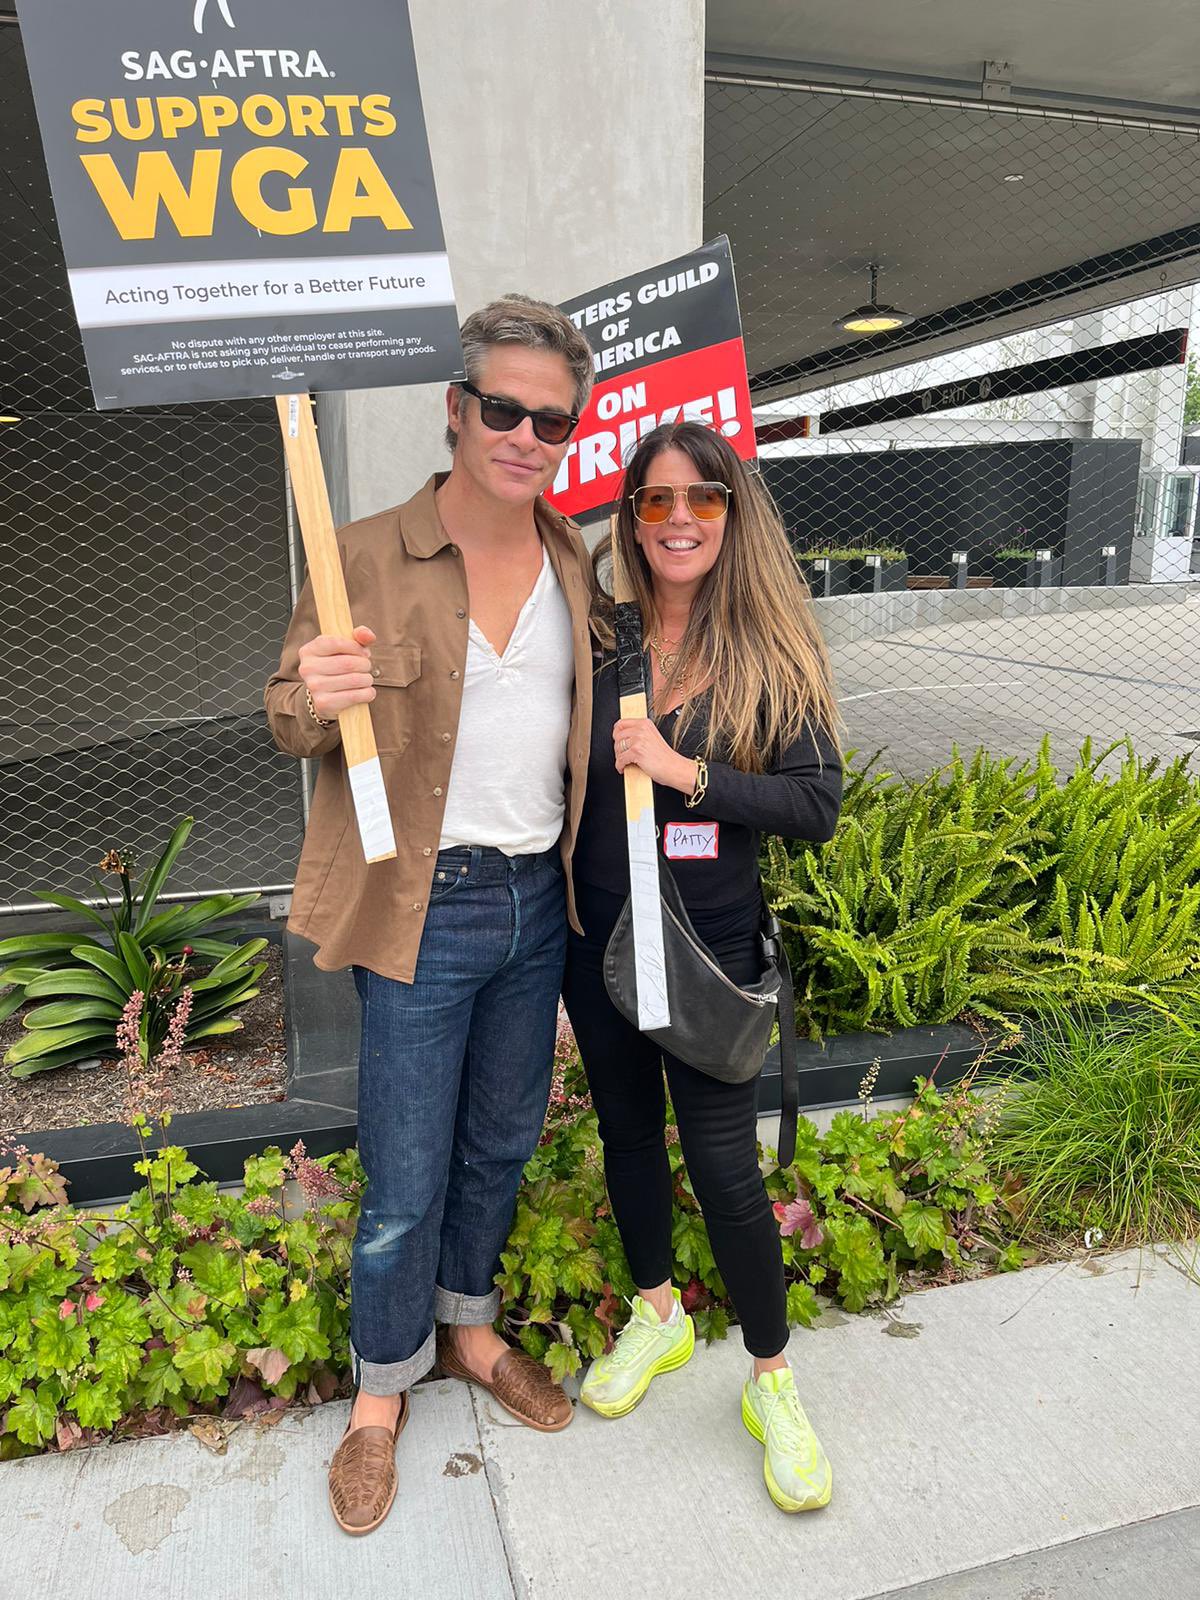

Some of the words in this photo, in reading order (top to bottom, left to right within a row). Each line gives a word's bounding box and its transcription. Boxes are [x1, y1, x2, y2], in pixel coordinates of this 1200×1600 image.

[70, 93, 397, 144] SUPPORTS
[79, 145, 415, 241] WGA
[105, 286, 169, 305] Acting
[172, 281, 259, 302] Together
[263, 280, 288, 296] for
[294, 282, 304, 294] a
[309, 278, 363, 294] Better
[369, 276, 426, 291] Future
[569, 291, 632, 329] TERS
[637, 262, 719, 303] GUILD
[171, 340, 185, 349] No
[187, 338, 223, 350] dispute
[225, 336, 247, 346] with
[248, 336, 266, 346] any
[266, 333, 292, 343] other
[293, 331, 336, 343] employer
[337, 330, 347, 339] at
[348, 329, 366, 338] this
[366, 328, 385, 337] site.
[601, 318, 630, 341] OF
[120, 365, 163, 376] services,
[164, 363, 175, 371] or
[175, 362, 187, 371] to
[188, 358, 218, 370] refuse
[219, 358, 231, 368] to
[232, 356, 252, 369] pick
[253, 356, 269, 366] up,
[270, 352, 304, 363] deliver,
[304, 350, 336, 362] handle
[336, 351, 347, 360] or
[348, 346, 391, 358] transport
[391, 345, 407, 356] any
[407, 344, 437, 355] goods.
[132, 353, 190, 364] SAG-AFTRA
[191, 350, 200, 359] is
[201, 349, 218, 359] not
[219, 346, 251, 357] asking
[252, 345, 270, 355] any
[270, 340, 316, 353] individual
[316, 343, 327, 351] to
[328, 341, 354, 350] cease
[355, 337, 404, 349] performing
[405, 335, 422, 345] any
[594, 326, 682, 373] ERICA
[597, 382, 647, 421] ON
[552, 386, 742, 495] TRIE!
[673, 827, 714, 852] PATTY
